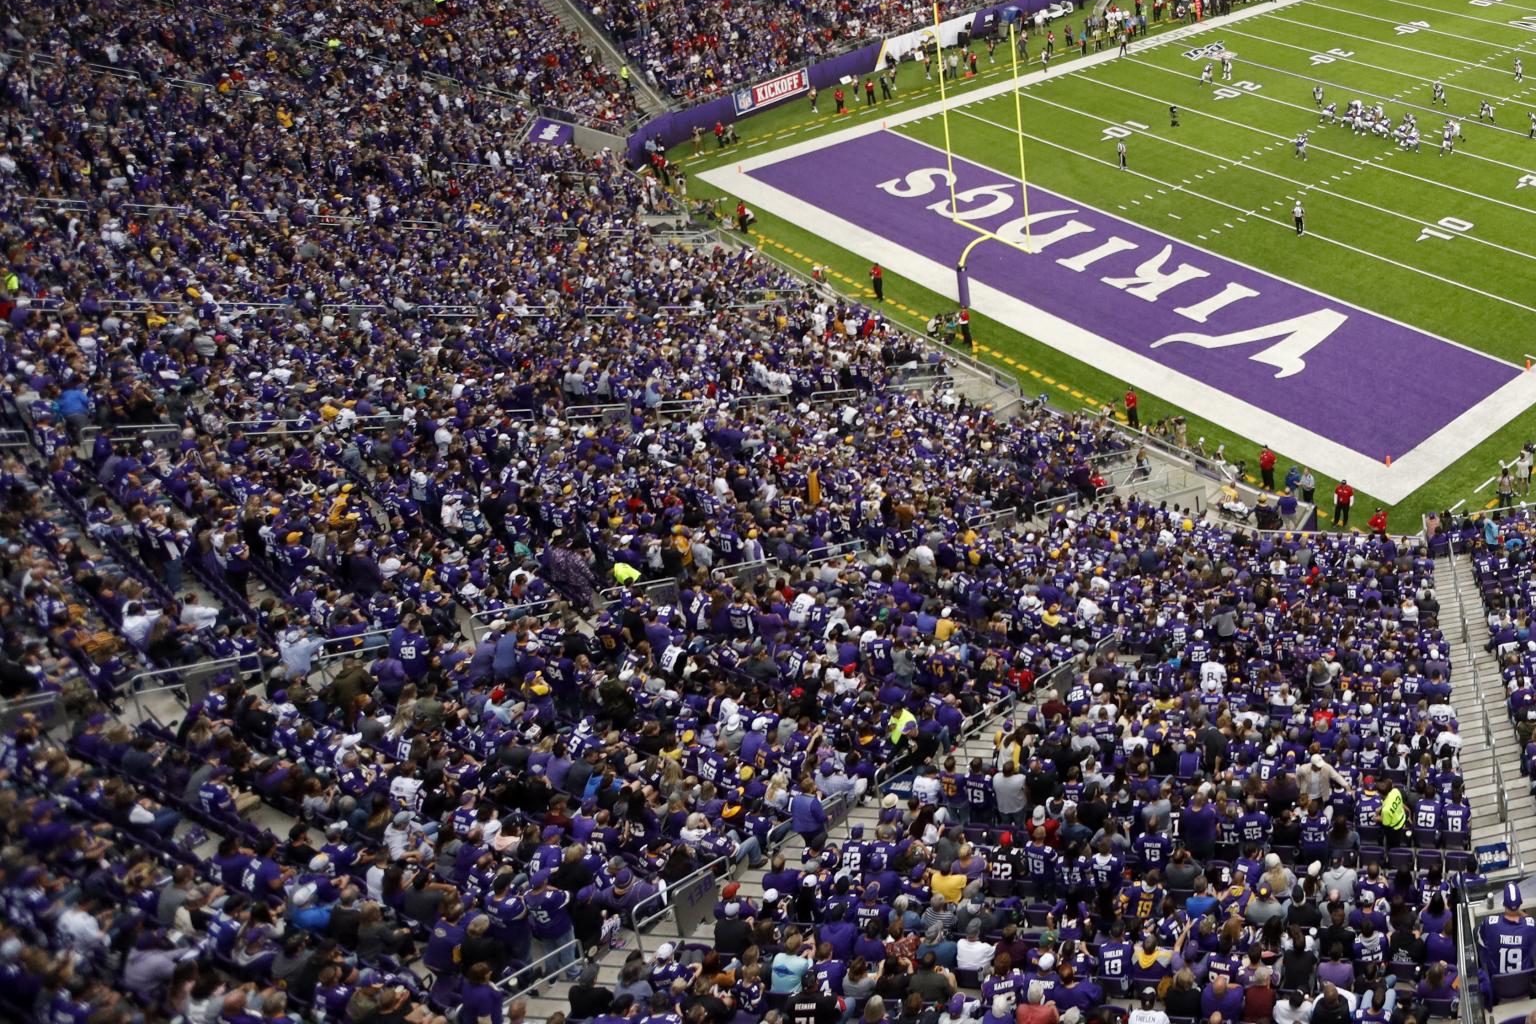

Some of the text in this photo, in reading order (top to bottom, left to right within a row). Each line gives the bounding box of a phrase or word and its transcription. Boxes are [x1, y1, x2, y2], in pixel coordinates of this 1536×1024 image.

[755, 74, 800, 102] KICKOFF
[1416, 216, 1475, 242] 10
[876, 167, 1349, 379] VIKINGS
[1417, 812, 1436, 828] 29
[1447, 817, 1462, 832] 19
[1028, 858, 1045, 875] 19
[1499, 934, 1523, 946] THIELEN
[1103, 949, 1123, 959] THIELEN
[1499, 947, 1522, 975] 19
[1104, 958, 1123, 975] 19
